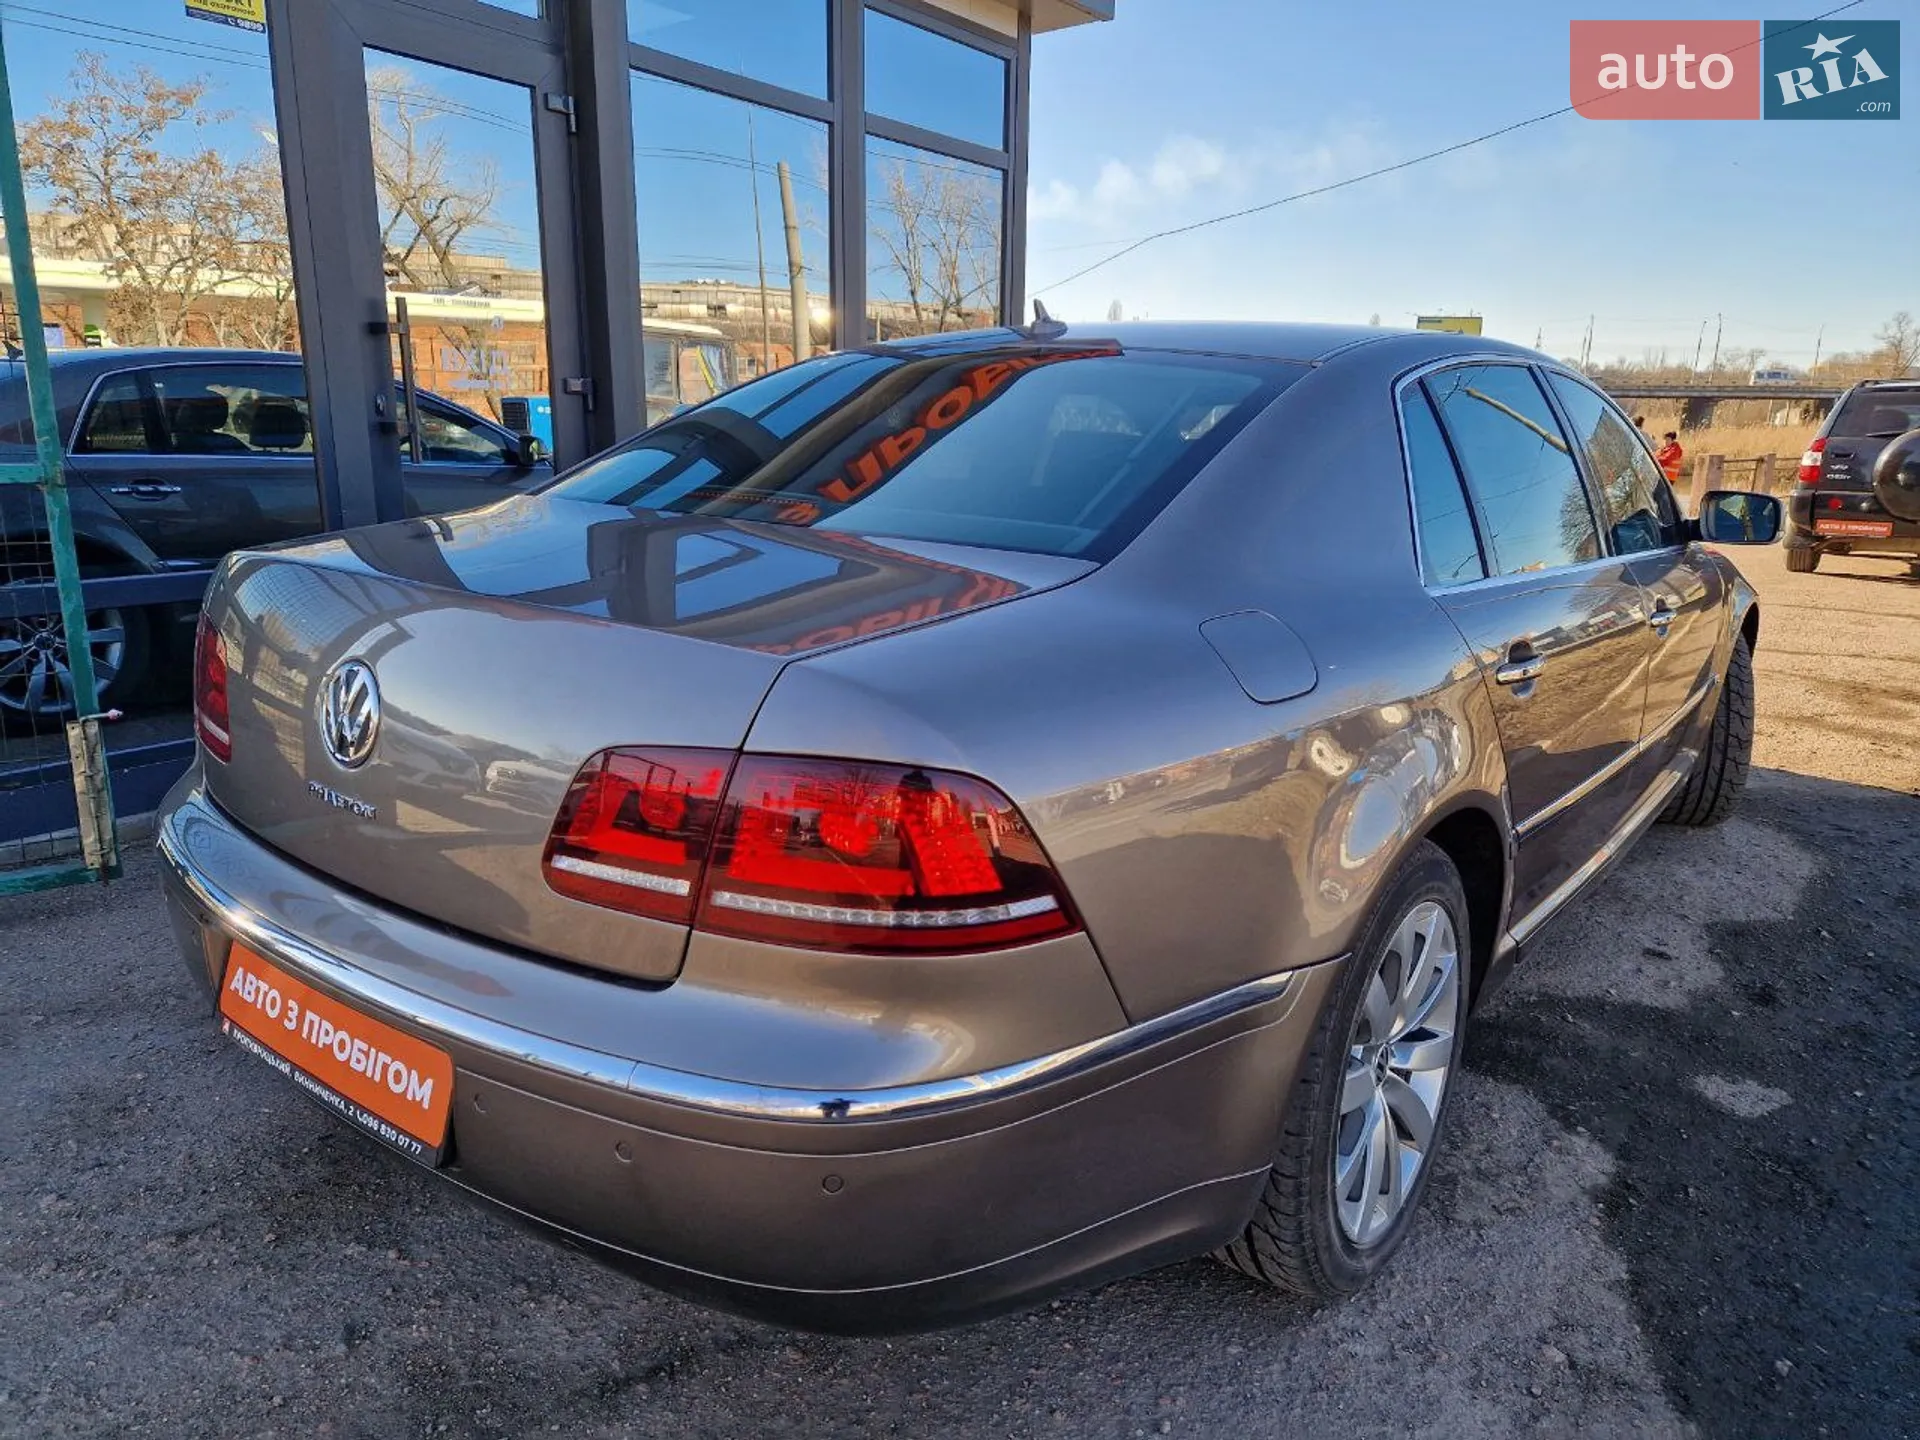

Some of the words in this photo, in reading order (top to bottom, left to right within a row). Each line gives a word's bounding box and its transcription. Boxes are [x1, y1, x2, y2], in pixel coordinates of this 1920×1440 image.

[229, 966, 282, 1019] АВТО
[283, 999, 298, 1031] З
[302, 1009, 434, 1110] ПРОБІГОМ
[348, 1105, 354, 1116] 2
[397, 1134, 410, 1149] 07
[410, 1141, 422, 1155] 77
